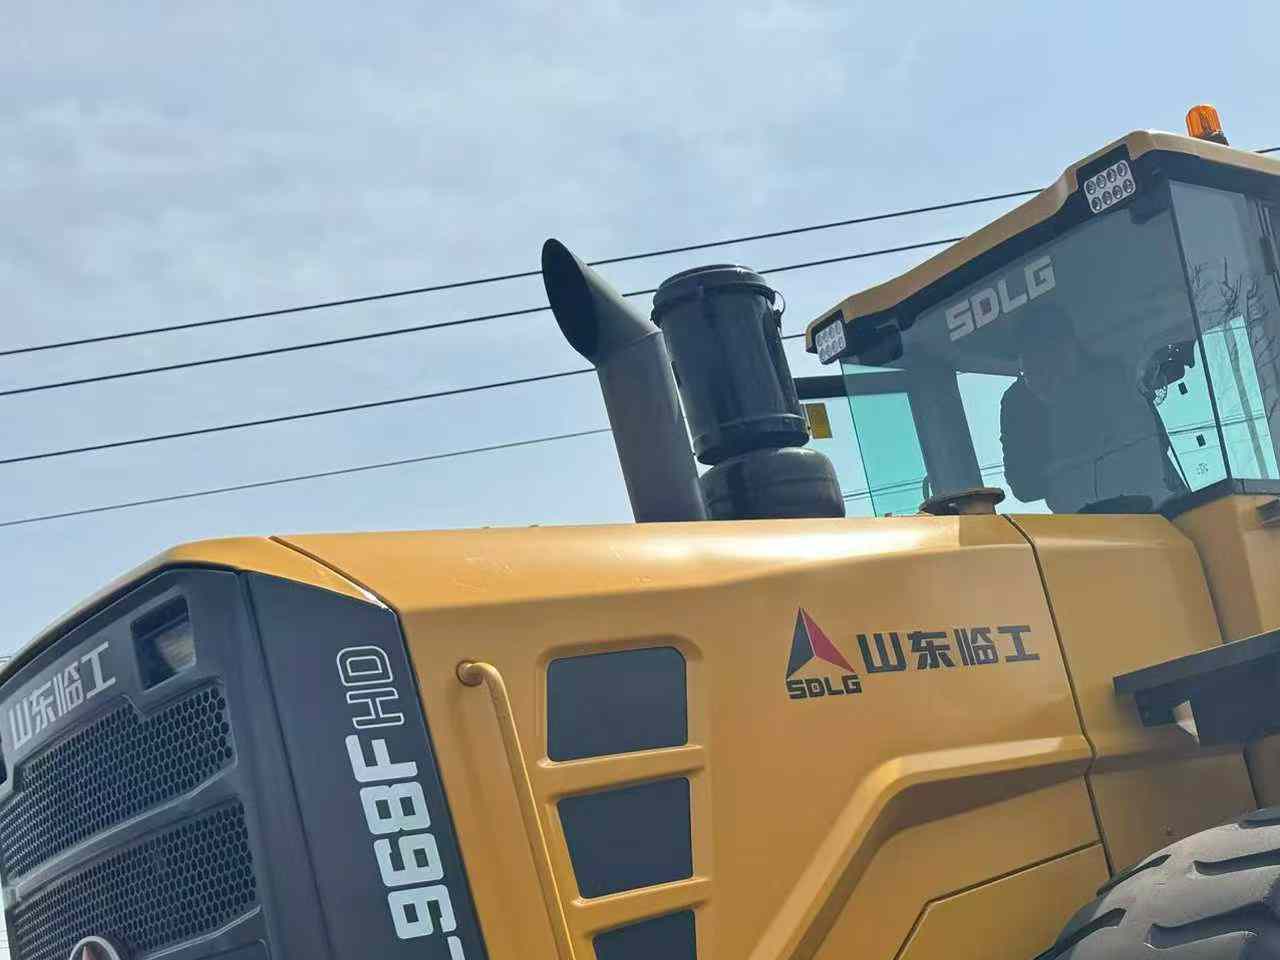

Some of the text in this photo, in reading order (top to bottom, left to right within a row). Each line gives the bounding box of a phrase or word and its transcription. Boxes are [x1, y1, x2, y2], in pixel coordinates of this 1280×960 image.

[945, 255, 1056, 341] SDLG
[857, 624, 1041, 674] 山东临工
[9, 640, 117, 751] 山东临工
[785, 674, 863, 699] SDLG
